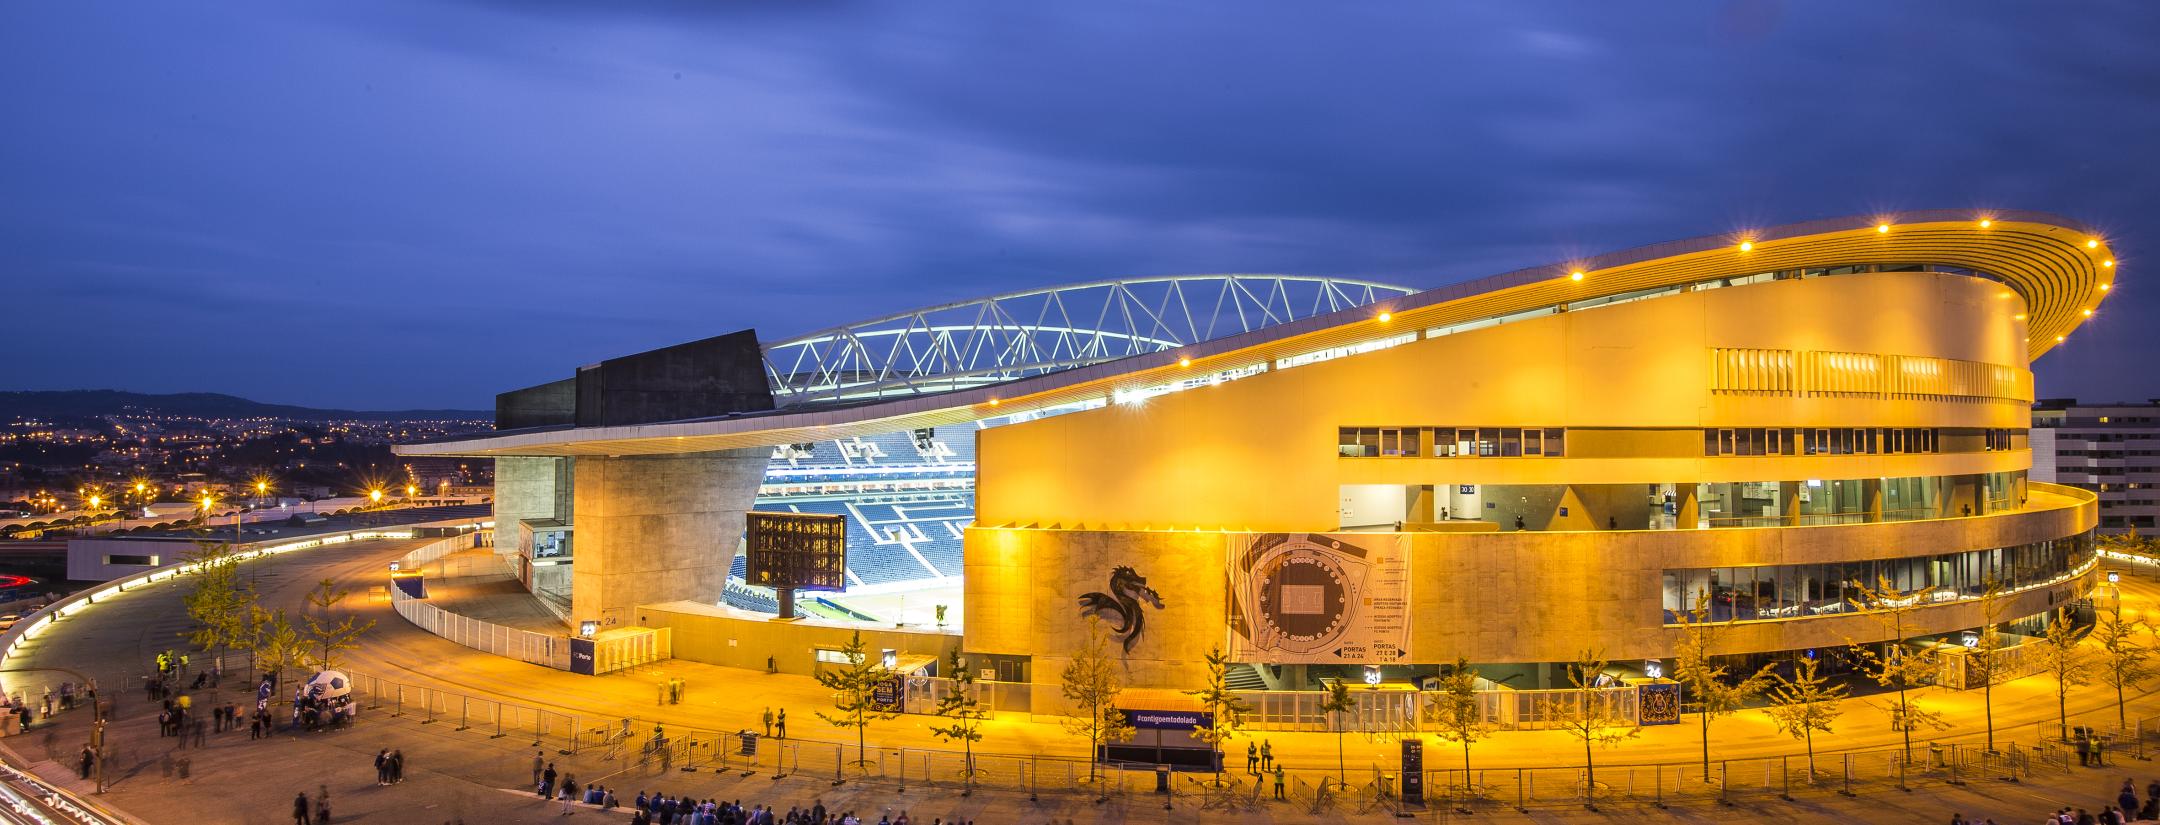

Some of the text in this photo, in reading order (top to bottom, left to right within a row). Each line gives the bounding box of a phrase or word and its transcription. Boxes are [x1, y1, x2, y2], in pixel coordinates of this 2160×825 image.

[1963, 636, 1979, 647] 27
[1647, 664, 1661, 678] 26
[1137, 715, 1197, 724] #contigoemtodolado
